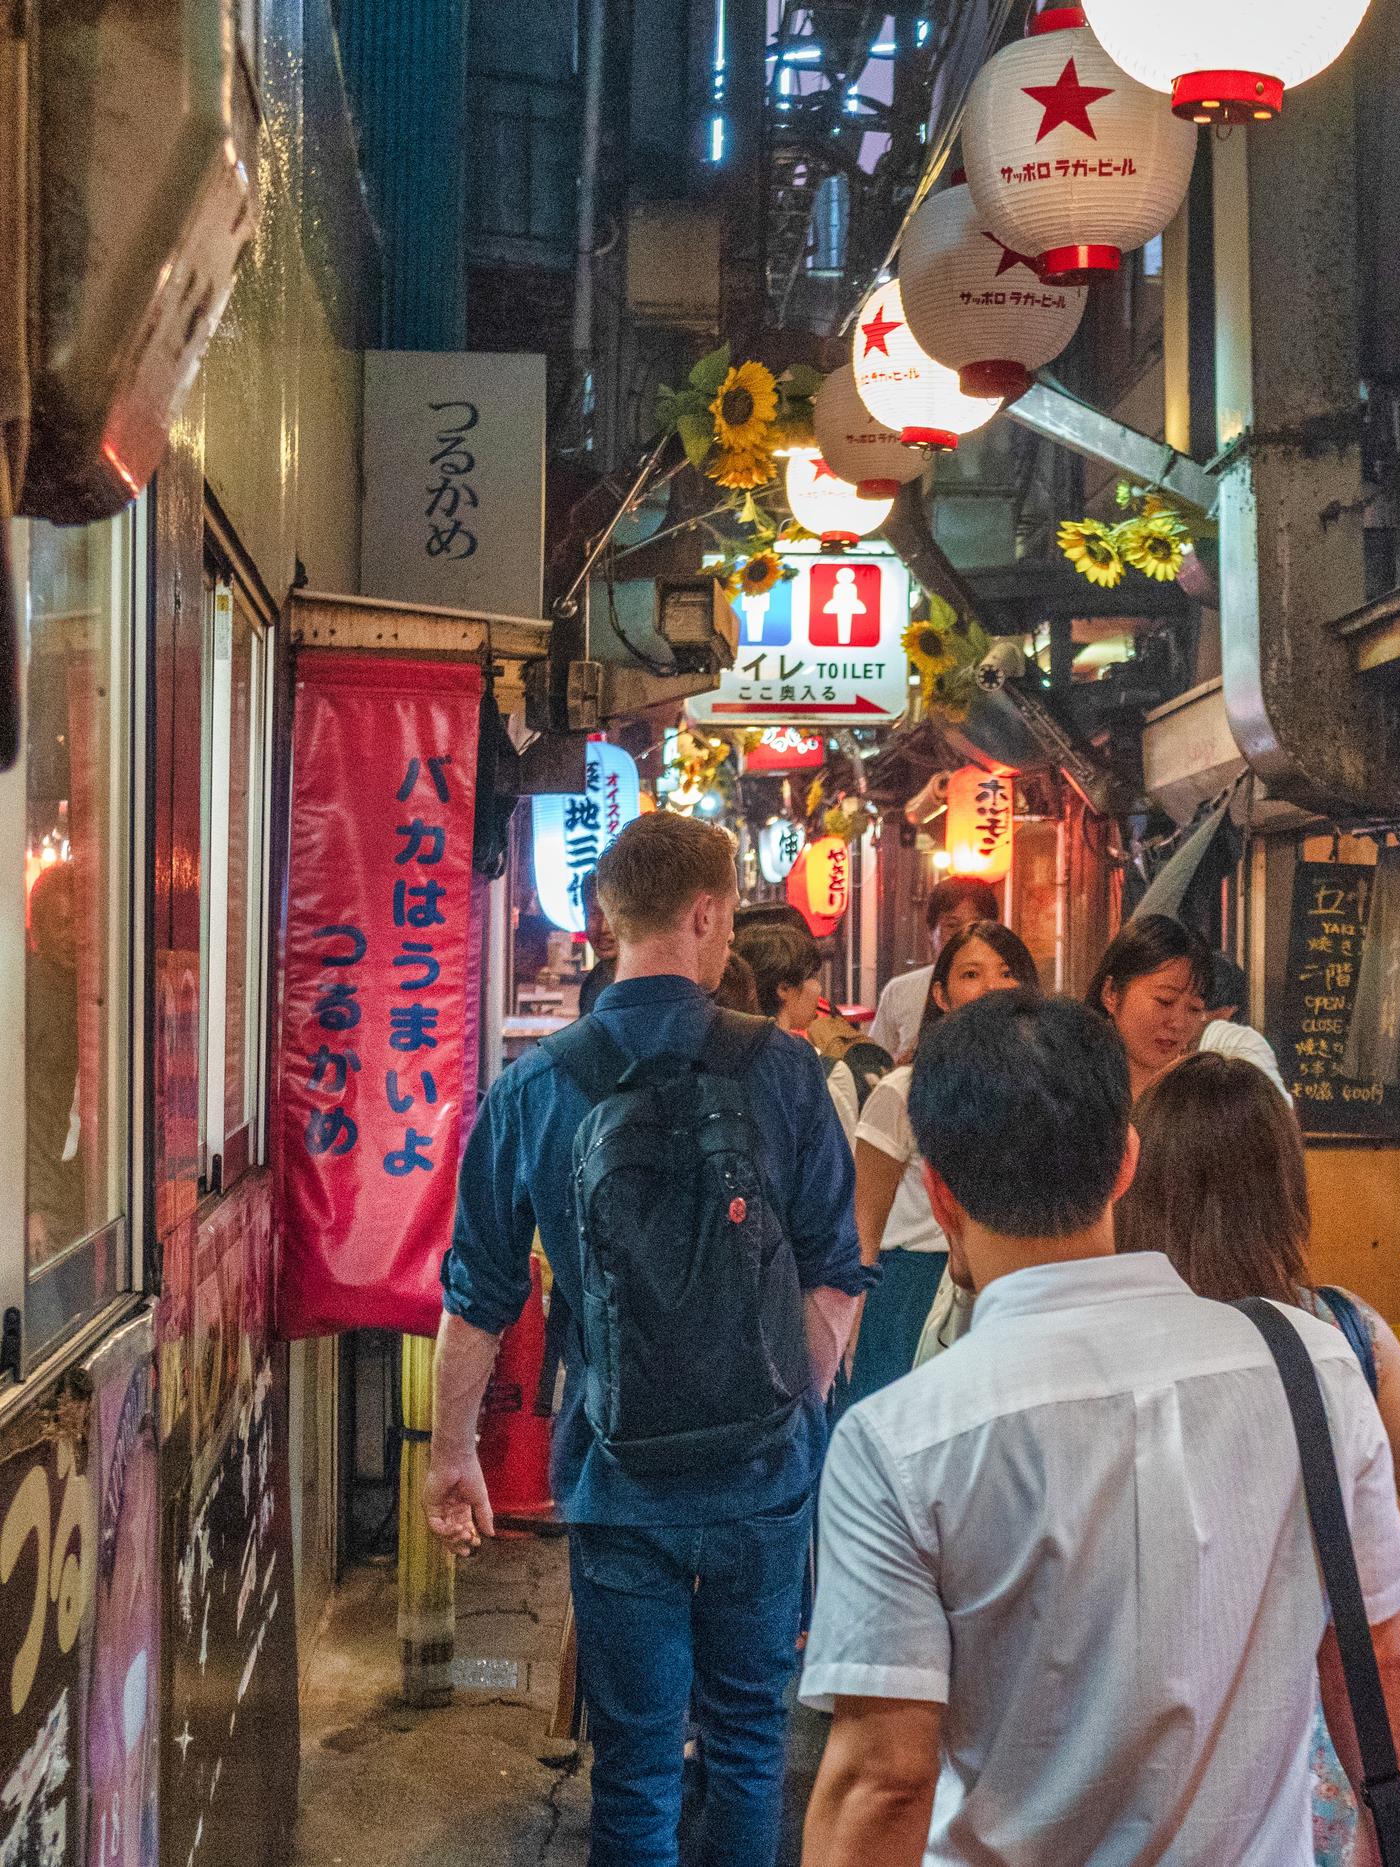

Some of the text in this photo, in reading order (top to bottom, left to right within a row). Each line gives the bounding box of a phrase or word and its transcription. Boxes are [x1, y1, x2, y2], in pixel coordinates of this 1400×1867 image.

[1000, 158, 1136, 183] サッポロ ラガービール
[959, 291, 1066, 309] サッポロ ラガービール
[425, 400, 480, 561] つるかめ
[816, 663, 886, 679] TOILET
[738, 685, 837, 702] ここ奥入る
[382, 755, 455, 1178] バカはうまいよ
[1304, 995, 1345, 1015] OPEN
[1302, 1018, 1343, 1034] CLOSE
[305, 923, 367, 1156] つるかめ
